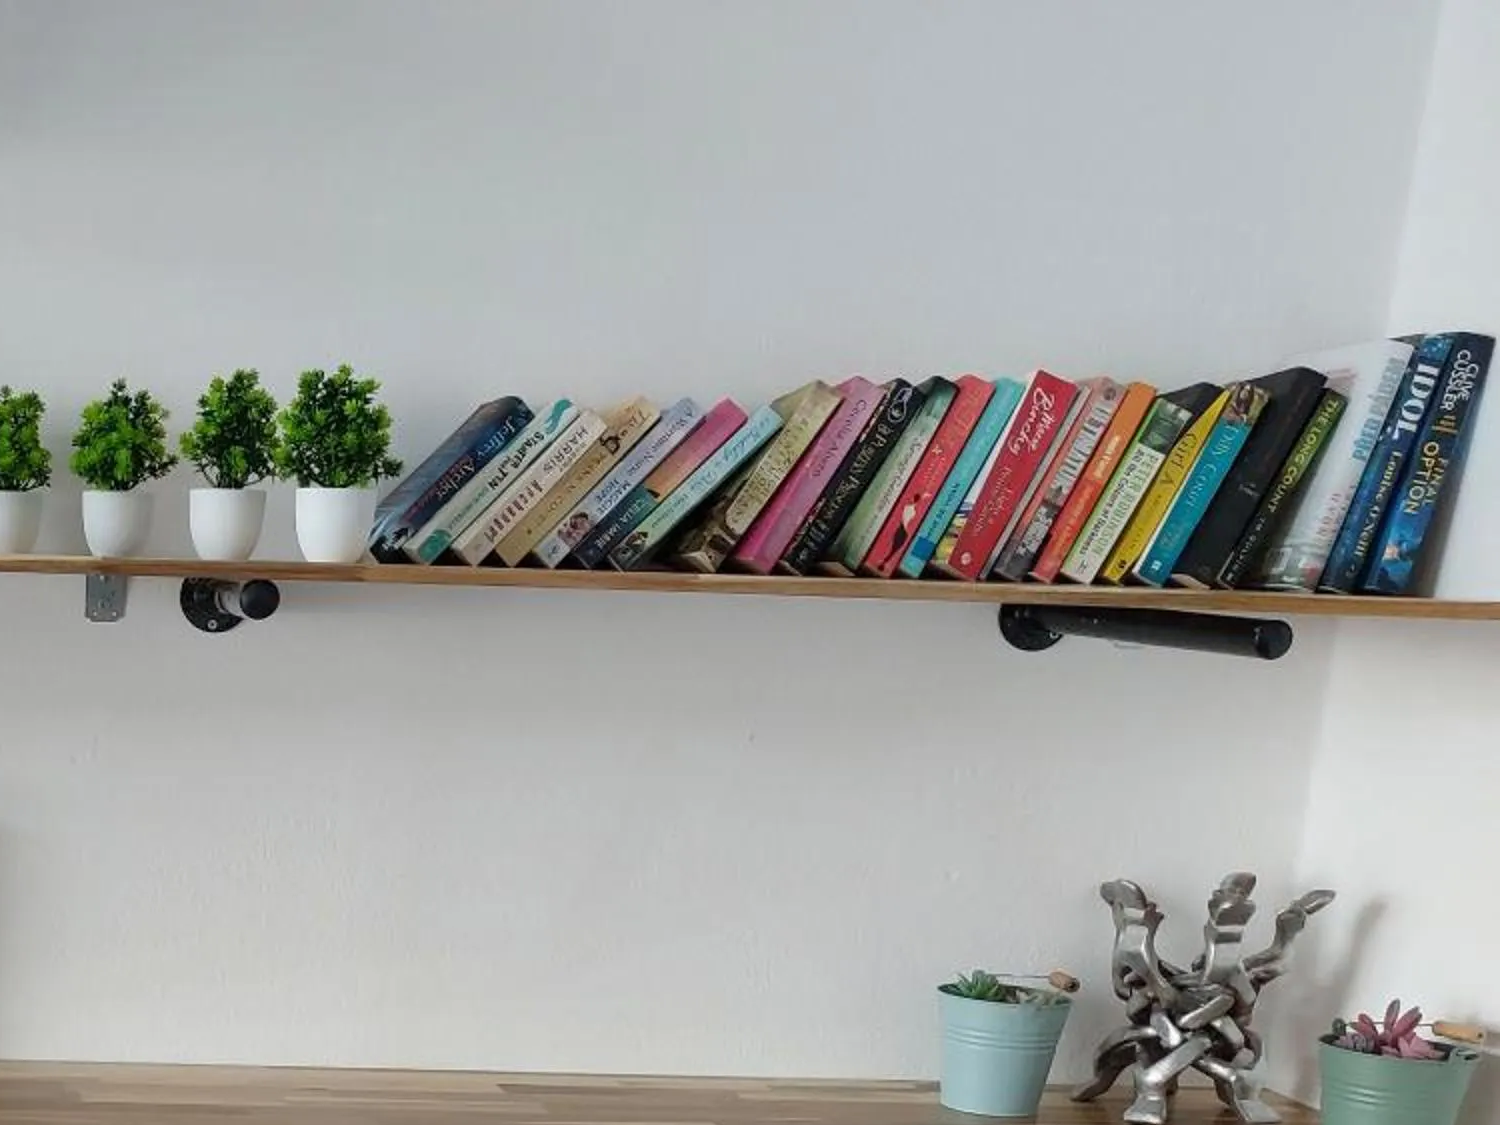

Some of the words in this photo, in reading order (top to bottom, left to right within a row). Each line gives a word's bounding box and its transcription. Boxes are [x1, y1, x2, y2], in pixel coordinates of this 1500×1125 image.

[1387, 359, 1441, 446] IDOL
[1437, 347, 1475, 413] CUSSLER
[1455, 361, 1480, 401] CLIVE
[1003, 384, 1057, 461] Binchy
[1316, 396, 1337, 424] THE
[472, 416, 519, 463] Jeffrey
[541, 425, 589, 475] HARRIS
[1291, 425, 1321, 465] LONG
[433, 457, 478, 502] Archer
[1263, 463, 1298, 513] COUNT
[1399, 438, 1442, 515] OPTION
[1420, 456, 1449, 509] FINAL
